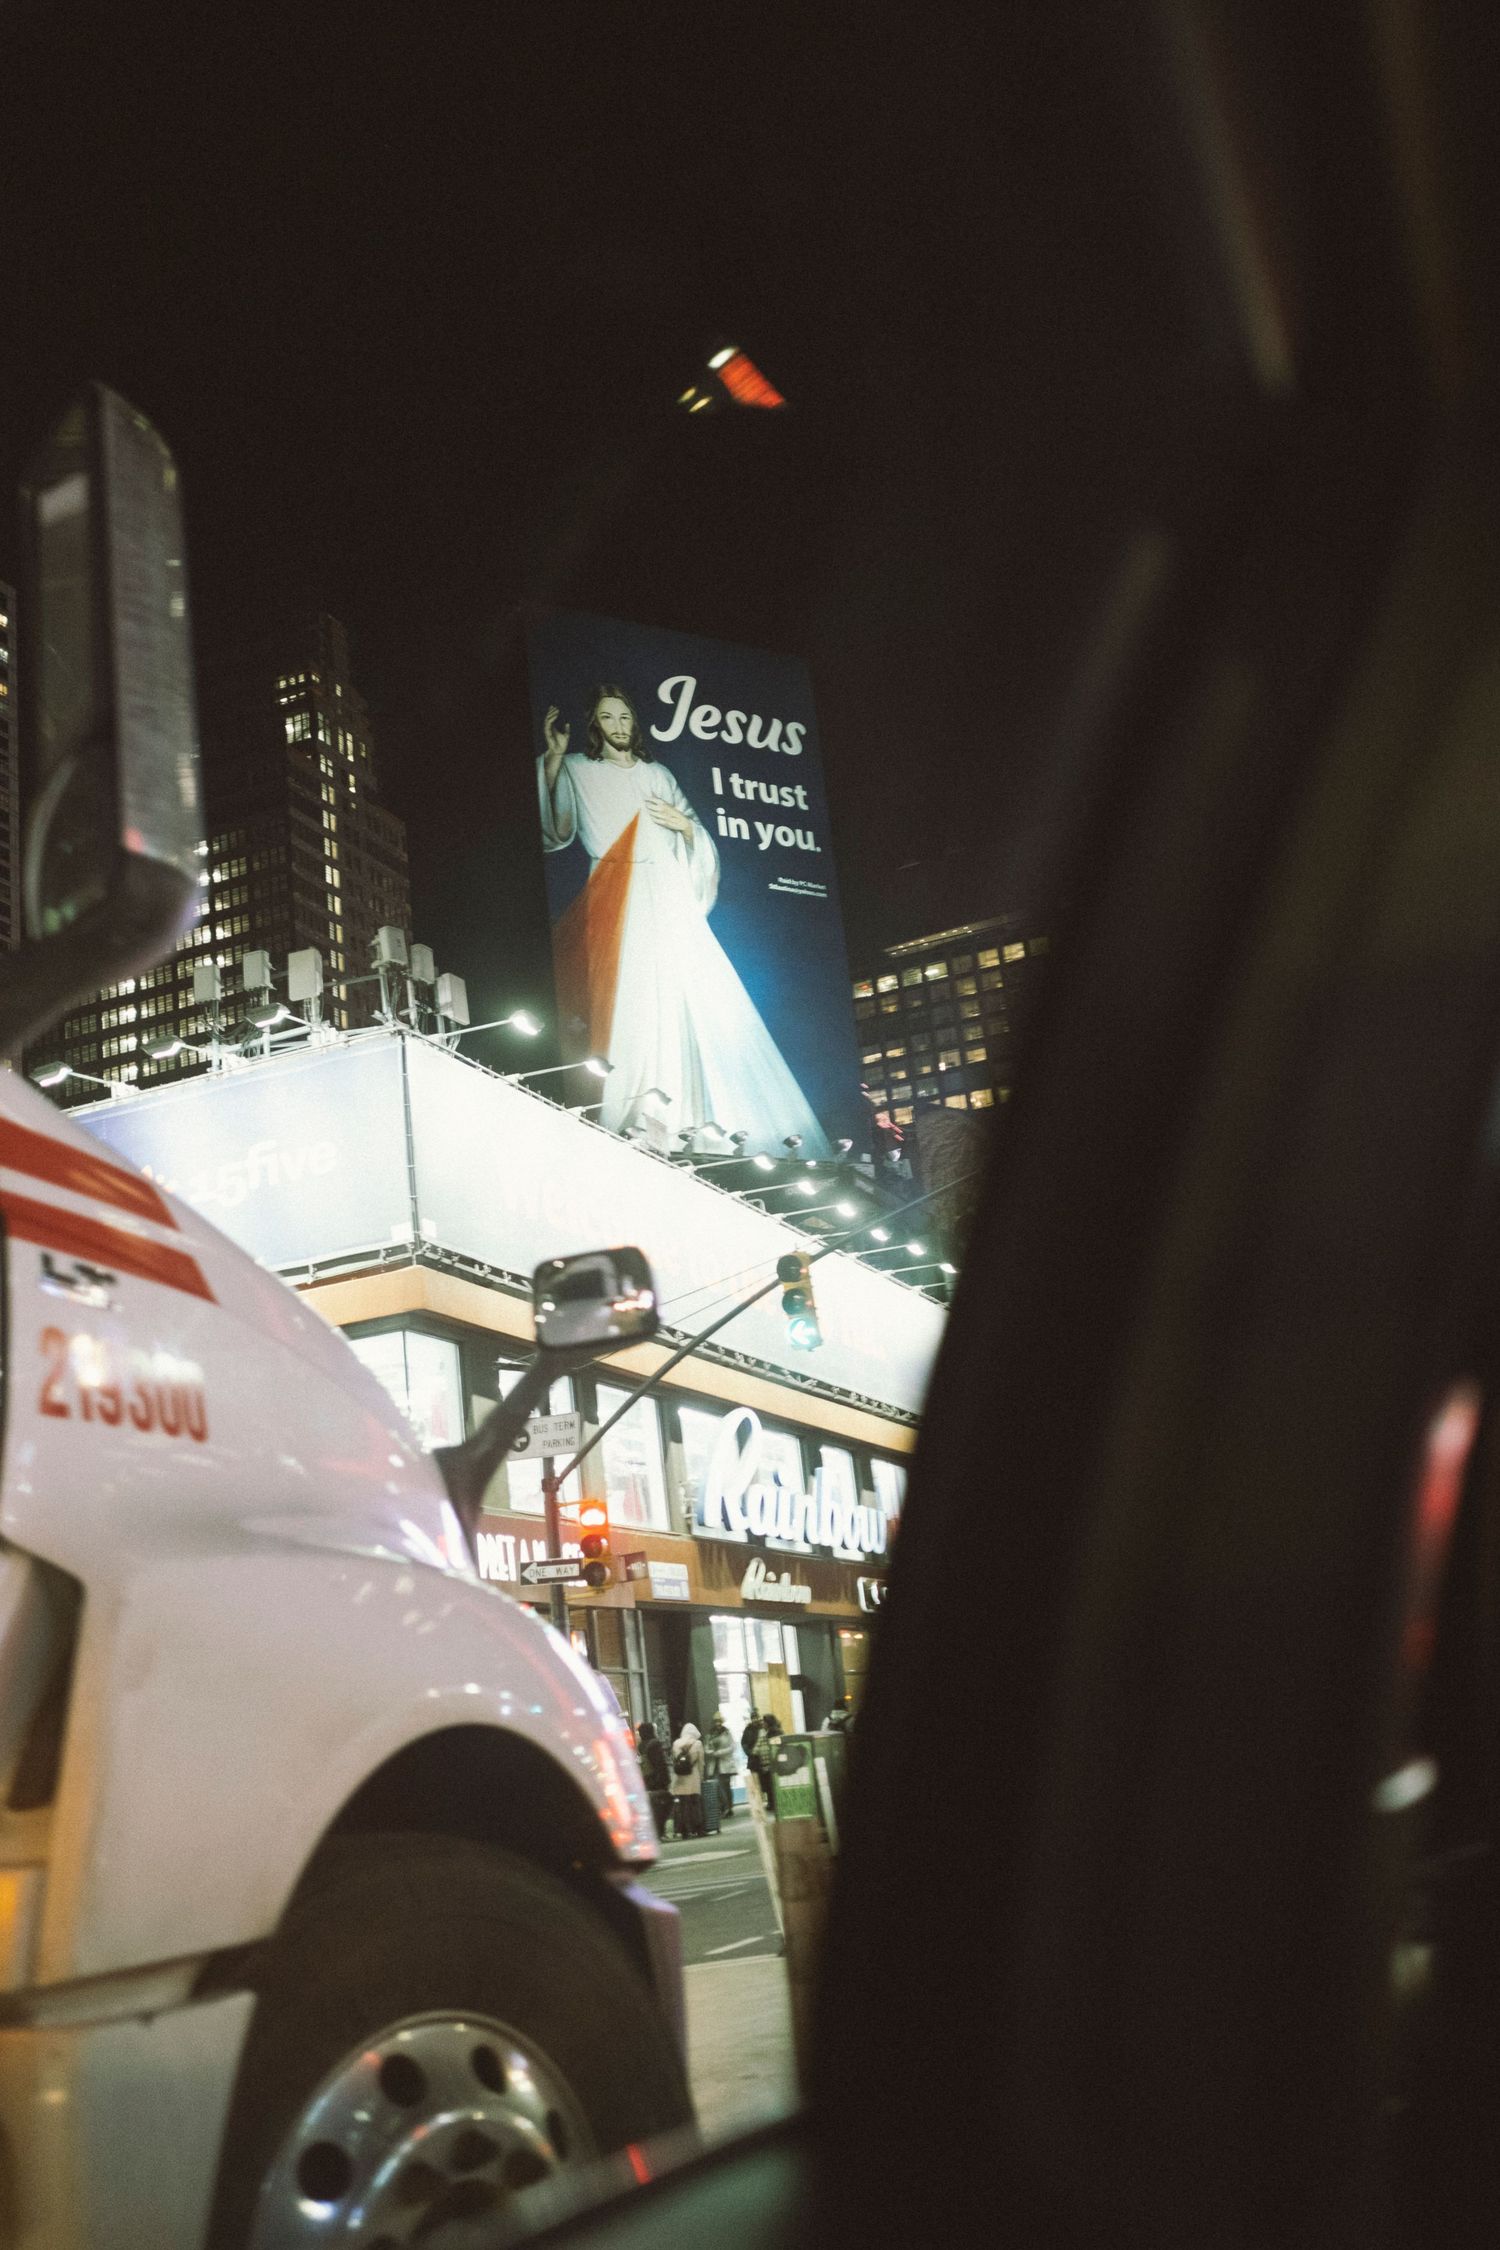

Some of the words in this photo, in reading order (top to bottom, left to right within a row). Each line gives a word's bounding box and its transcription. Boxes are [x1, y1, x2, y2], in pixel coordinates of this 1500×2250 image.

[650, 674, 807, 755] Jesus
[711, 766, 724, 796] I
[729, 772, 809, 810] trust
[716, 807, 751, 840] in
[753, 821, 822, 852] you.
[532, 1422, 549, 1435] BUS
[542, 1437, 576, 1449] PARKING
[703, 1406, 888, 1555] Rainbow
[529, 1569, 547, 1579] ONE
[555, 1565, 576, 1576] WAY
